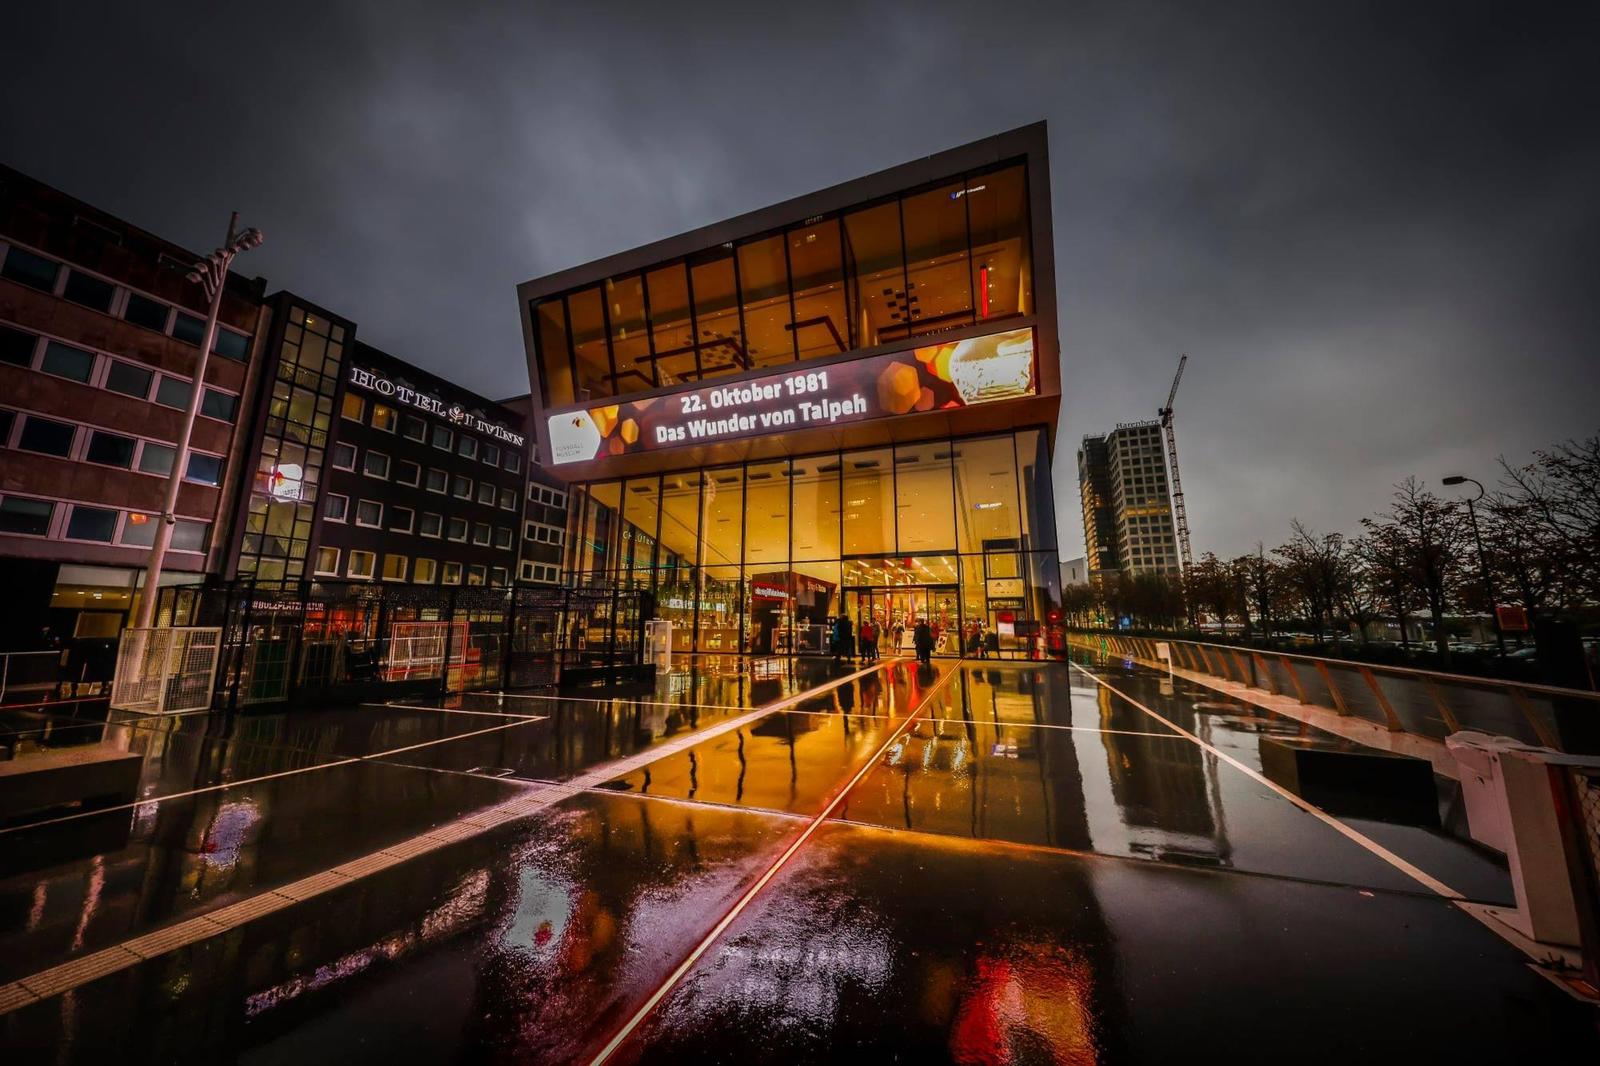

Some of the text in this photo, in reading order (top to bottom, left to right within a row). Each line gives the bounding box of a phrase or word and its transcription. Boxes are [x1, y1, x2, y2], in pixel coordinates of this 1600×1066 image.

[350, 367, 447, 418] HOTEL
[680, 371, 828, 414] 22. Oktober 1981
[656, 425, 686, 443] Das
[688, 413, 757, 438] Wunder
[760, 408, 795, 427] von
